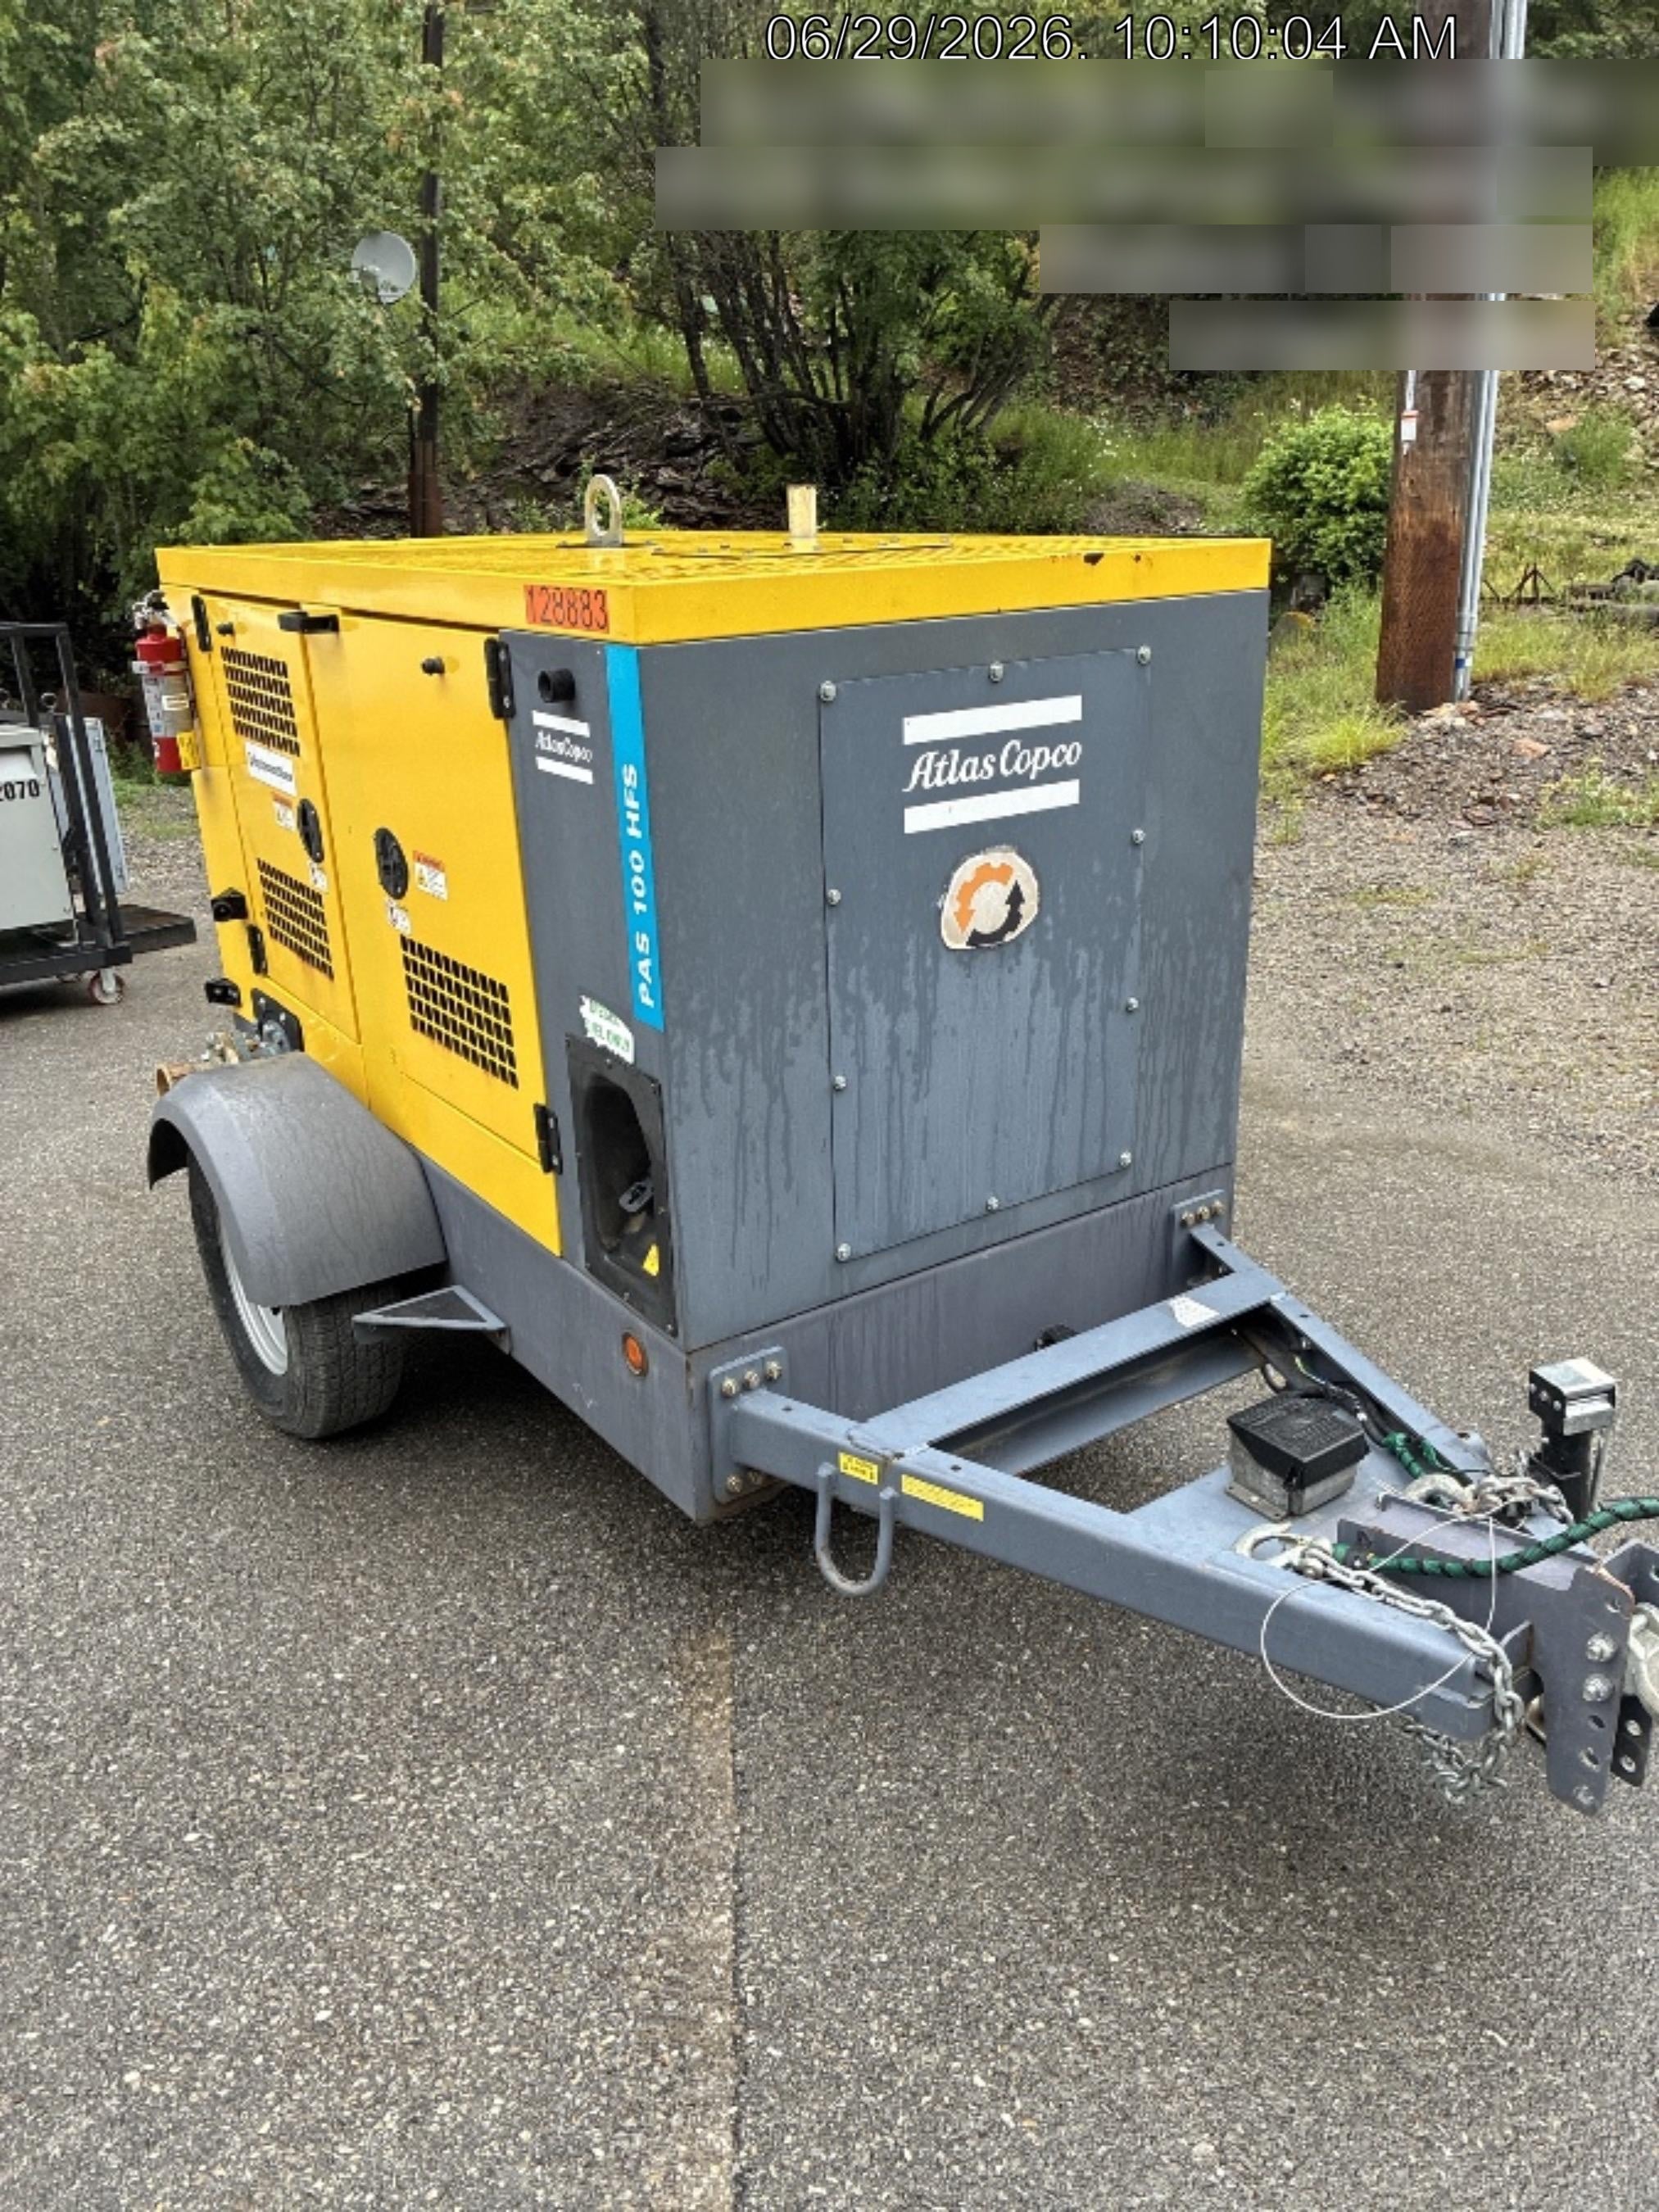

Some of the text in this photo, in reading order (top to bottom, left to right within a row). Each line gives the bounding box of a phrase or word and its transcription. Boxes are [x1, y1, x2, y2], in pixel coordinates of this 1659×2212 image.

[527, 585, 608, 630] 128883
[902, 739, 1082, 793] Atlas Copco
[622, 764, 655, 1009] PAS 100 HFS
